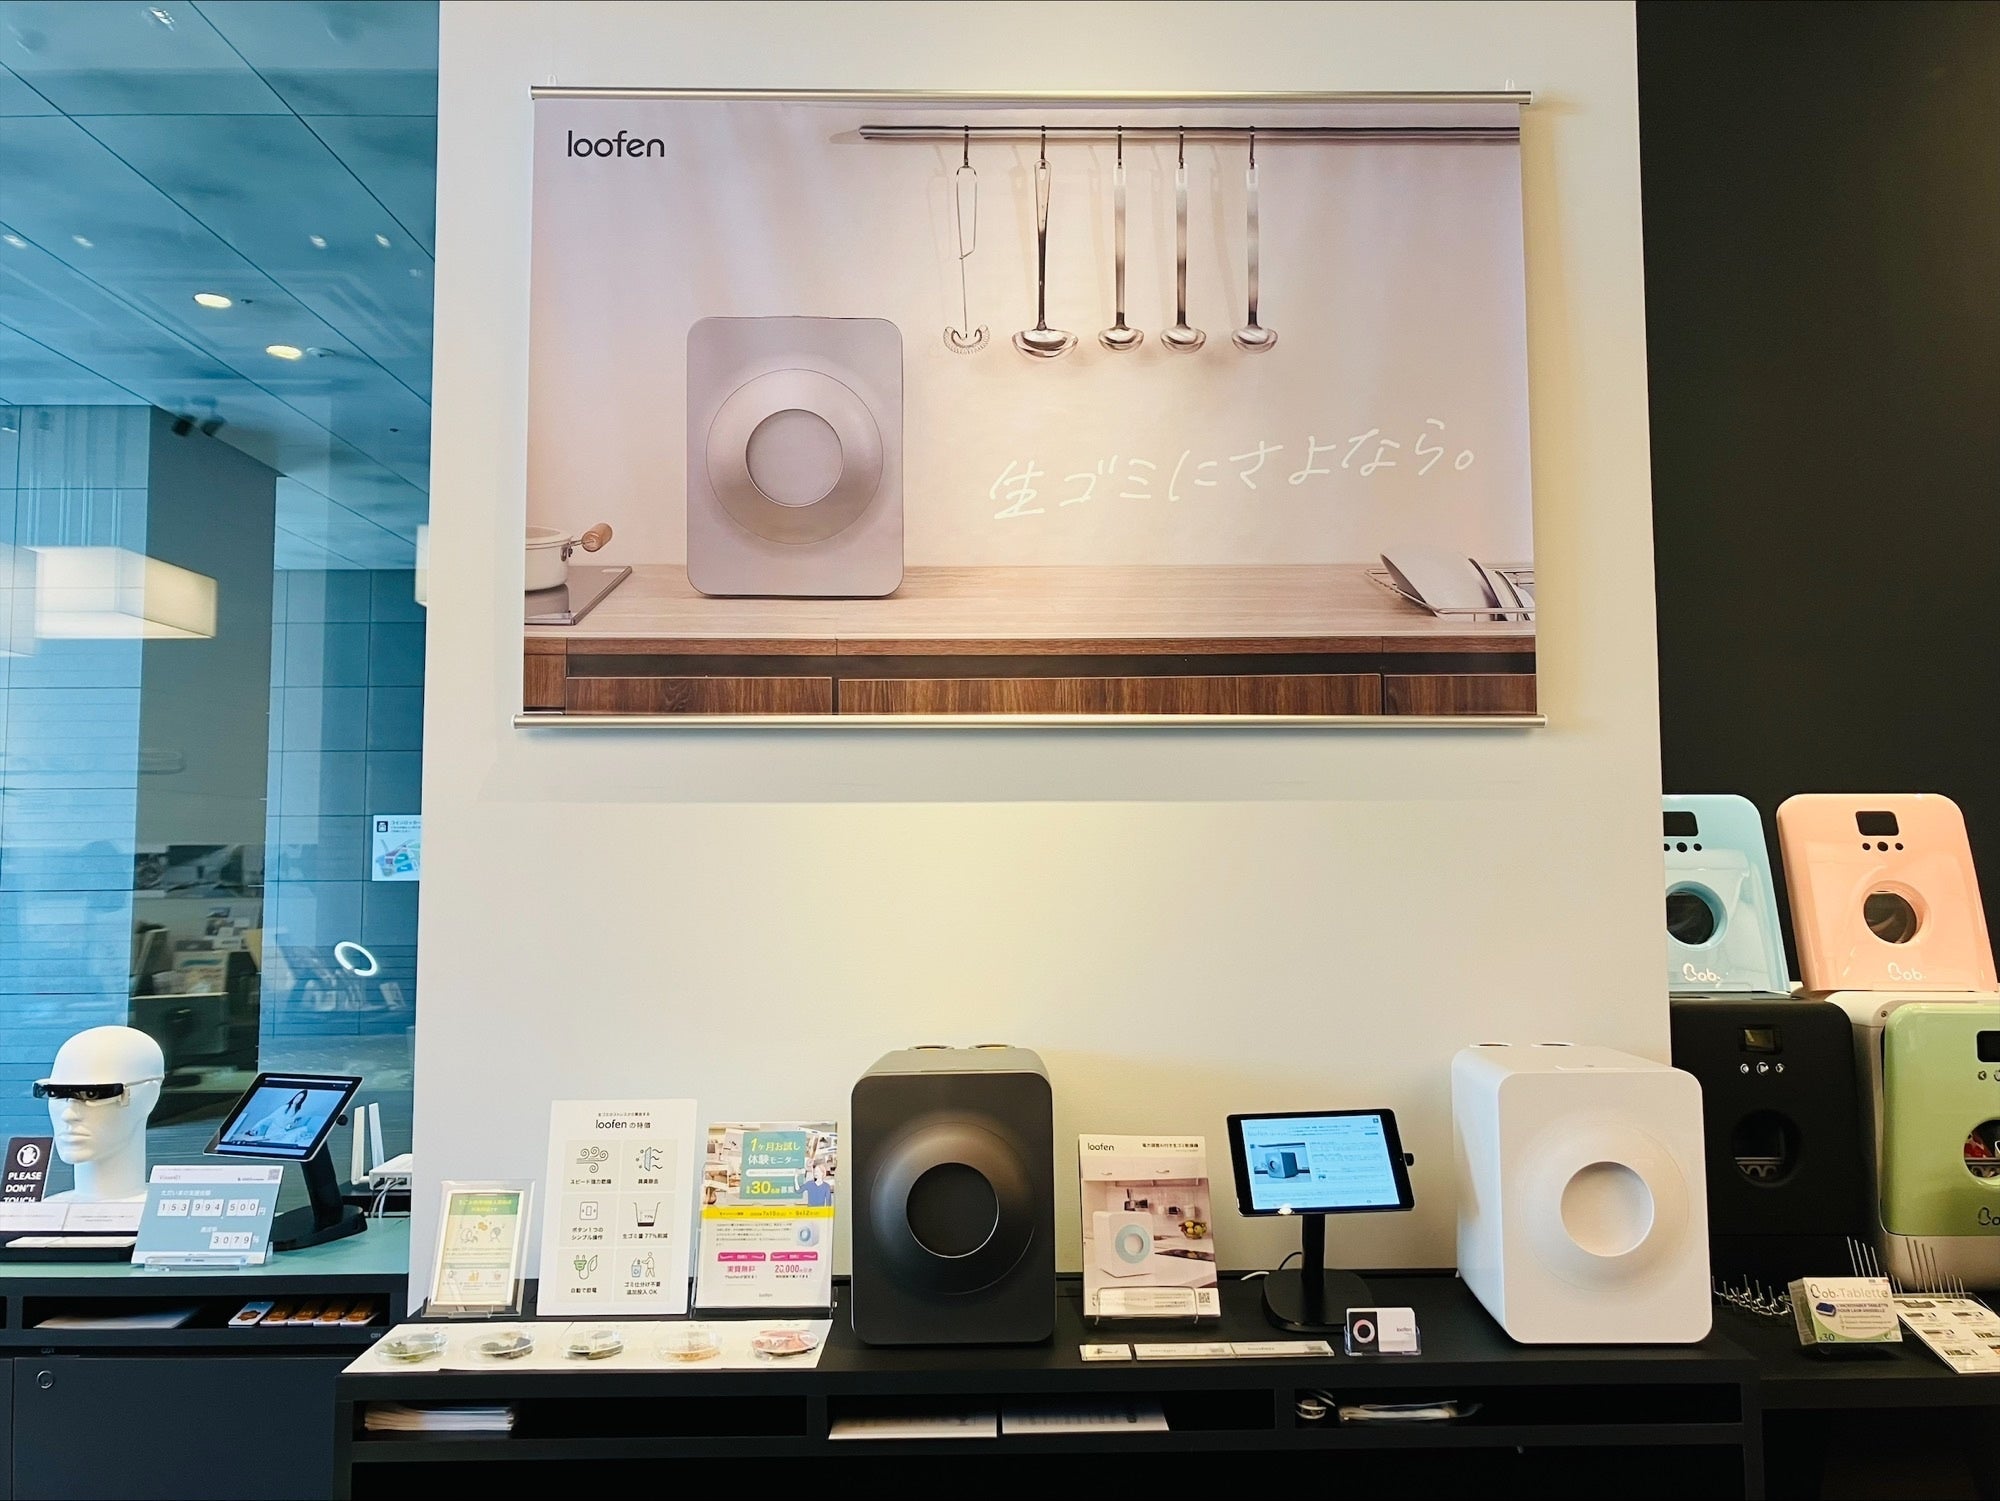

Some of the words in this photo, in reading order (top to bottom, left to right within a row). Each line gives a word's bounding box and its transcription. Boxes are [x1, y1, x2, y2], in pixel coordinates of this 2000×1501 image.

[567, 130, 665, 157] loofen
[989, 417, 1474, 519] 生ゴミにさよなら。
[1087, 1143, 1115, 1151] loofen
[8, 1171, 43, 1180] PLEASE
[5, 1184, 36, 1193] DON'T
